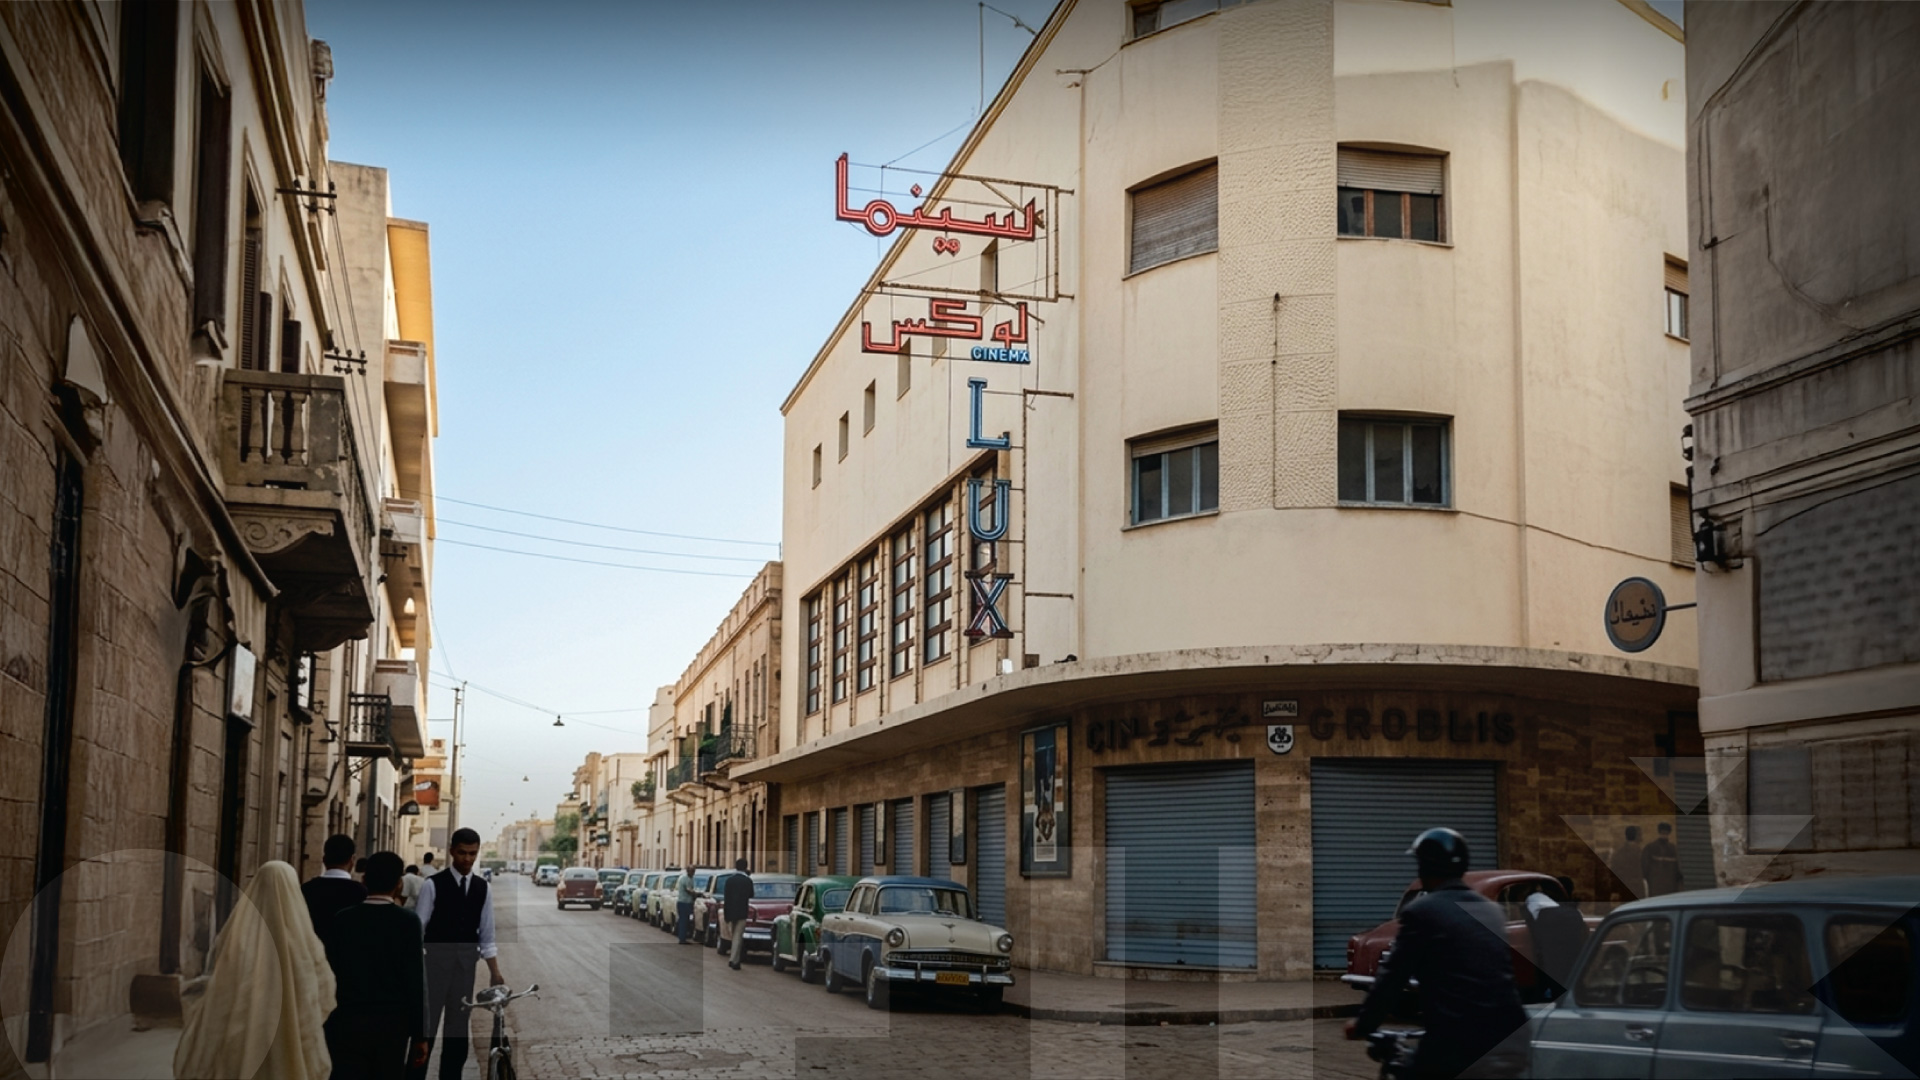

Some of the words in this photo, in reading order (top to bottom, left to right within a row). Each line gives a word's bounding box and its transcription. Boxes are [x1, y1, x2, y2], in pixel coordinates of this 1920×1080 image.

[836, 152, 1035, 256] سينما
[862, 297, 1028, 353] لوكس
[965, 376, 1015, 639] LUX
[1309, 707, 1515, 744] GROBLIS
